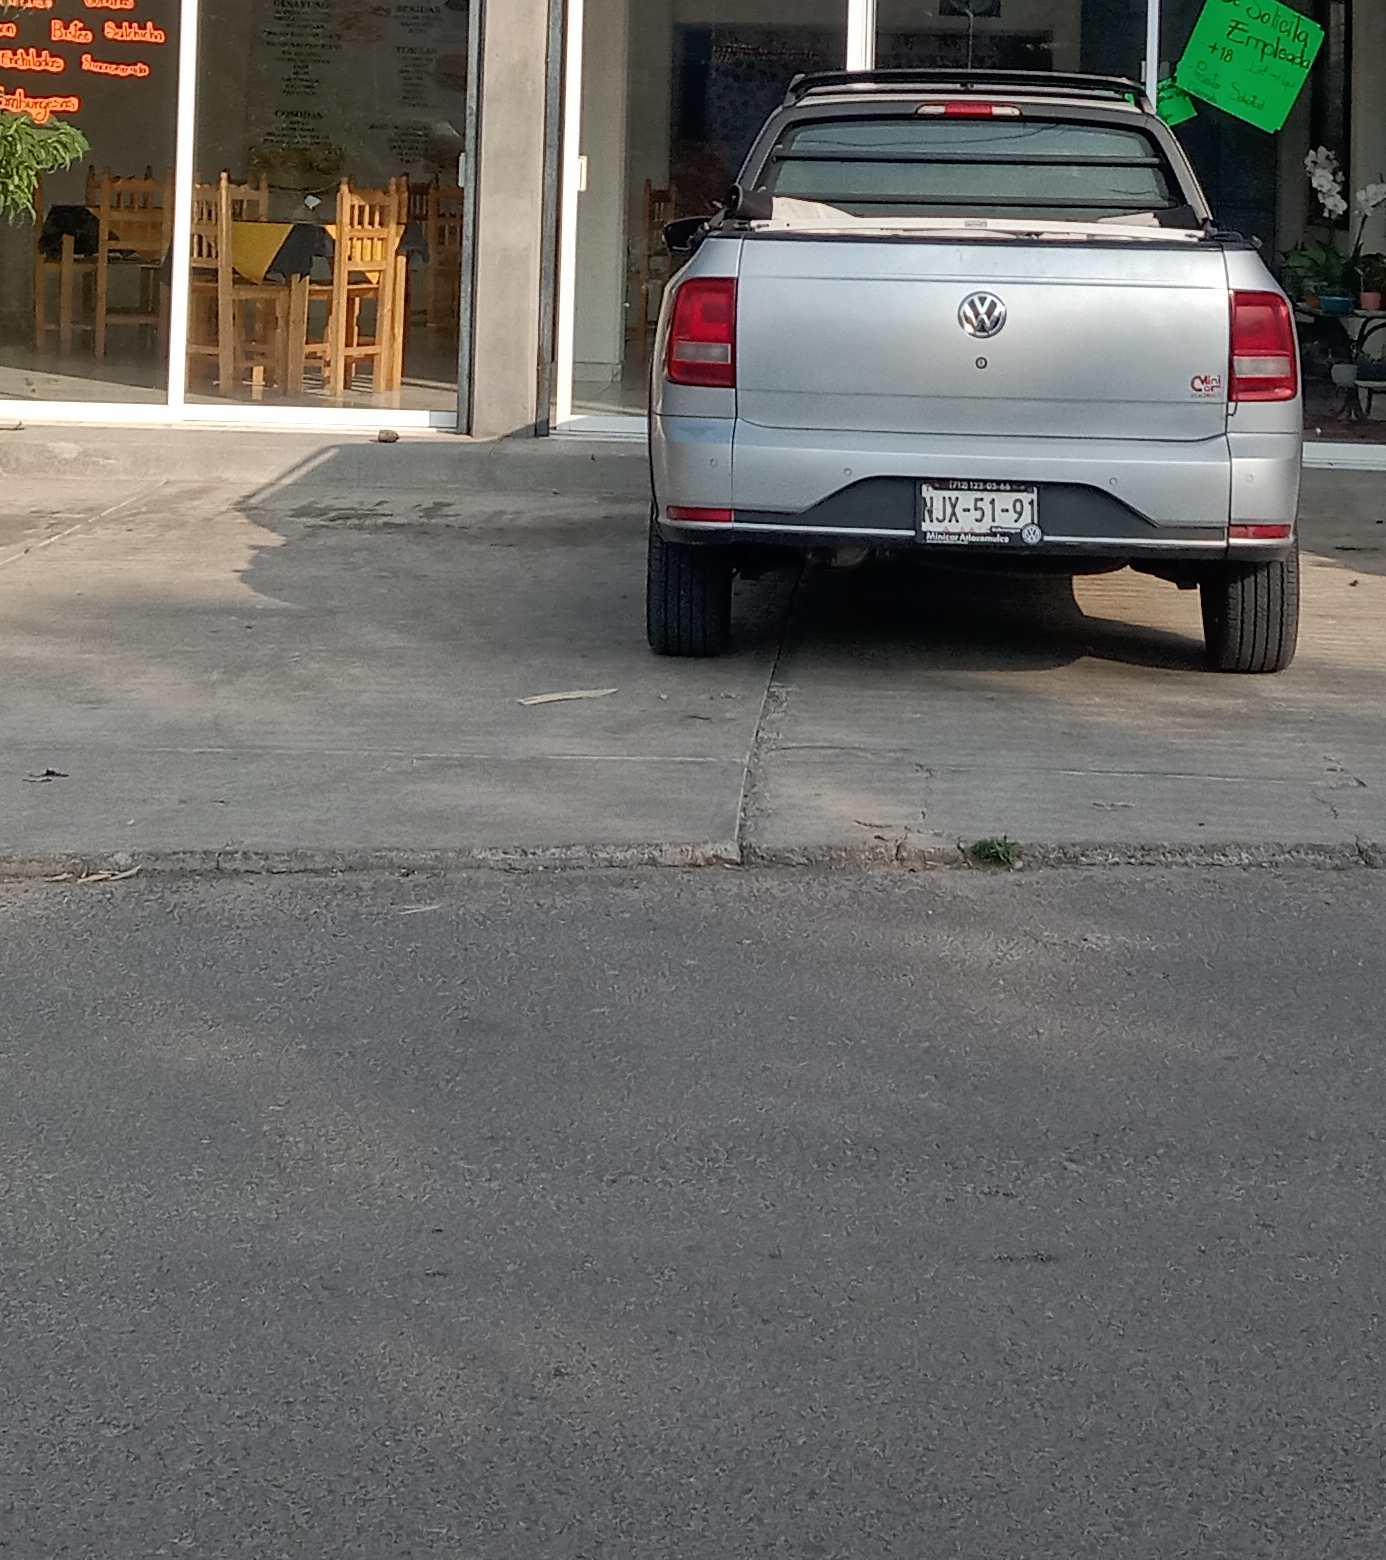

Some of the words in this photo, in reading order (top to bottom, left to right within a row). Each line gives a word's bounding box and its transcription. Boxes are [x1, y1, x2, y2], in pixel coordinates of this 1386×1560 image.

[1208, 42, 1234, 63] +18
[1225, 18, 1311, 70] Empleada
[922, 495, 1035, 523] NJX-51-91
